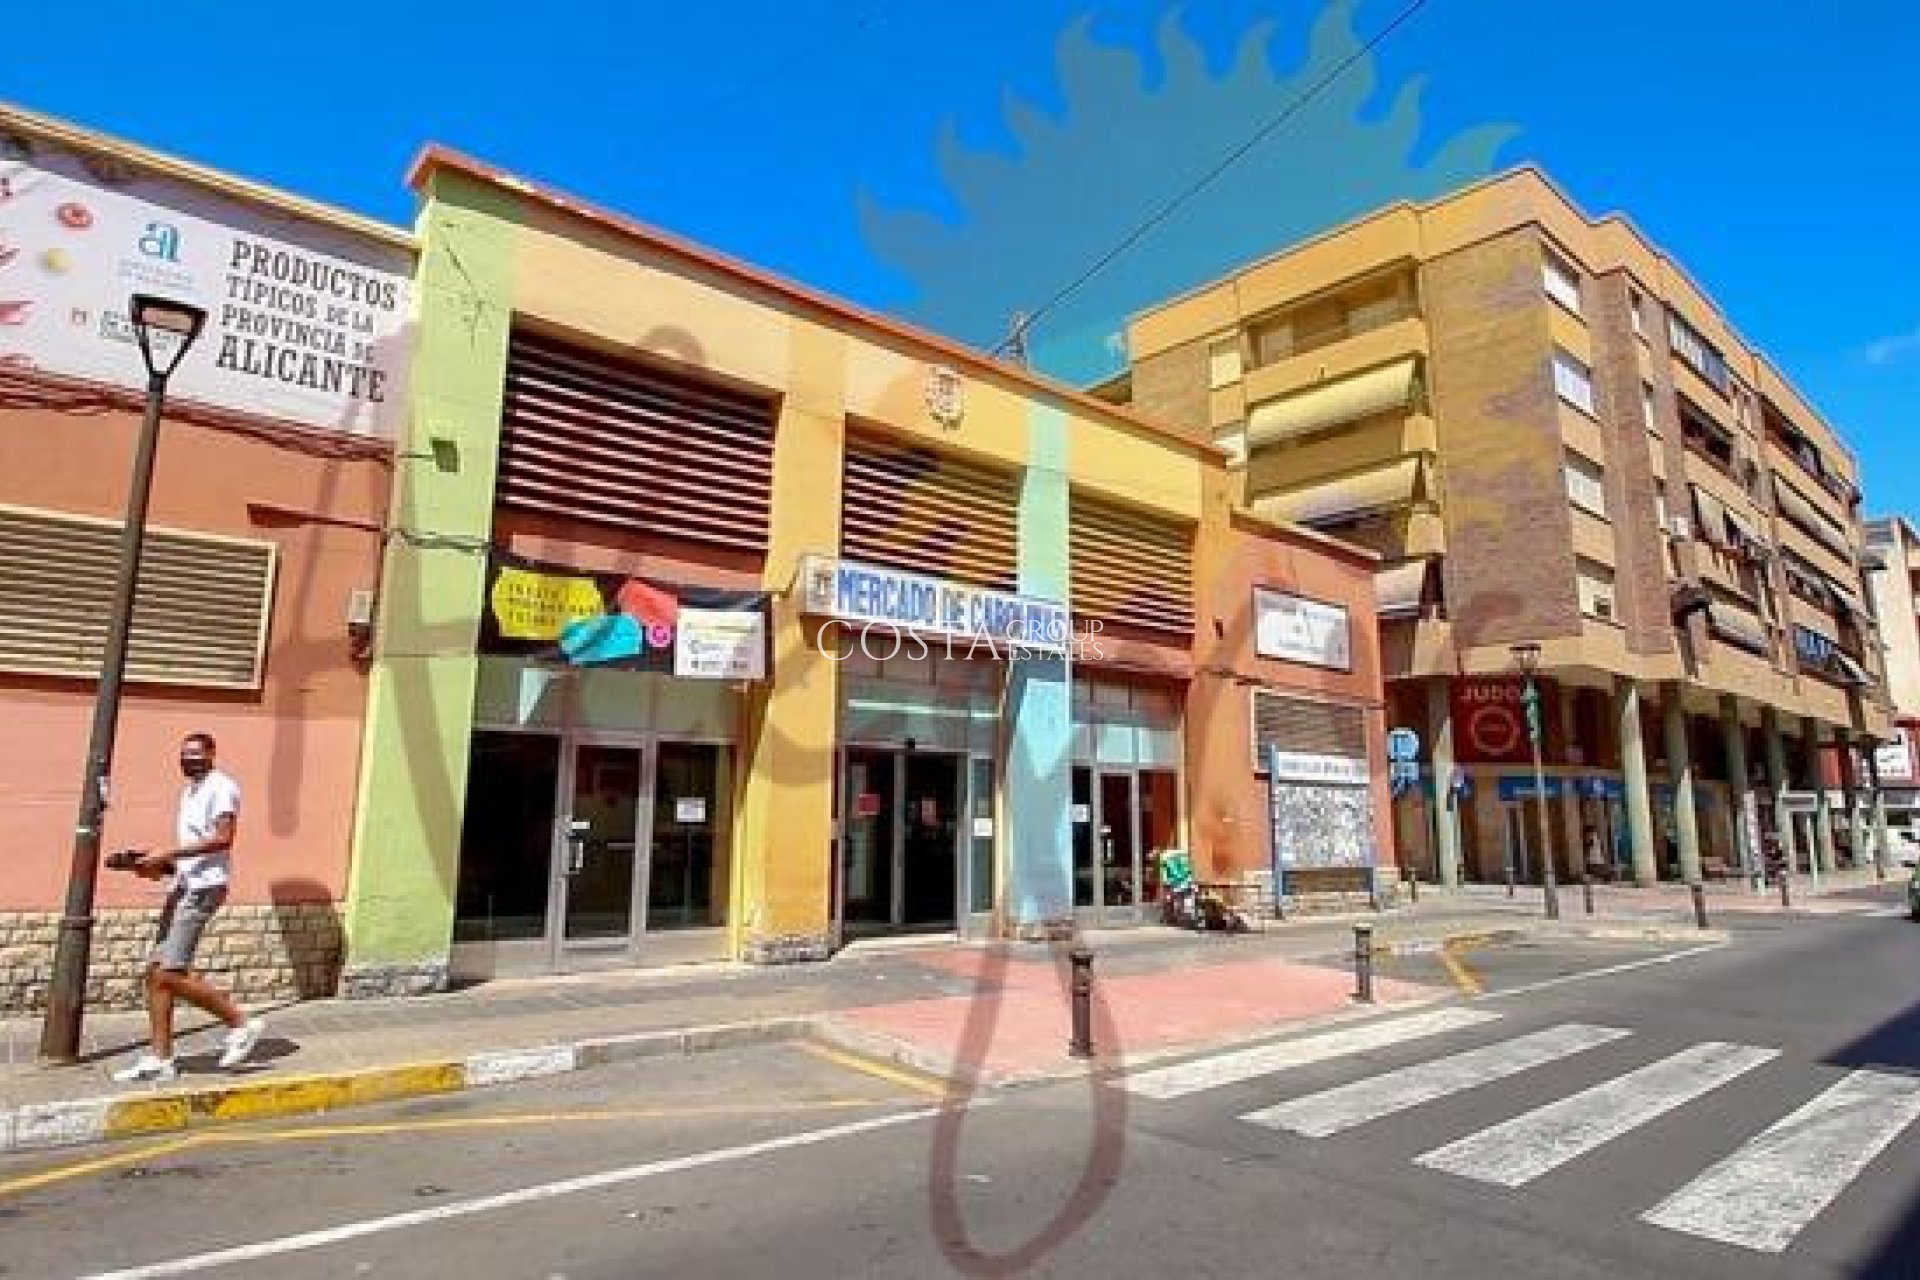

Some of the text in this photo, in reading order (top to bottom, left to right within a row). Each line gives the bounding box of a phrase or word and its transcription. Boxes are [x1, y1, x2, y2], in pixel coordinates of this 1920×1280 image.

[231, 240, 397, 311] PRODUCTOS
[219, 304, 346, 353] PROVINCIA
[325, 304, 348, 325] DE
[351, 311, 374, 333] LA
[216, 335, 387, 402] ALICANTE
[838, 568, 936, 628] MERCADO
[942, 584, 966, 635] DE
